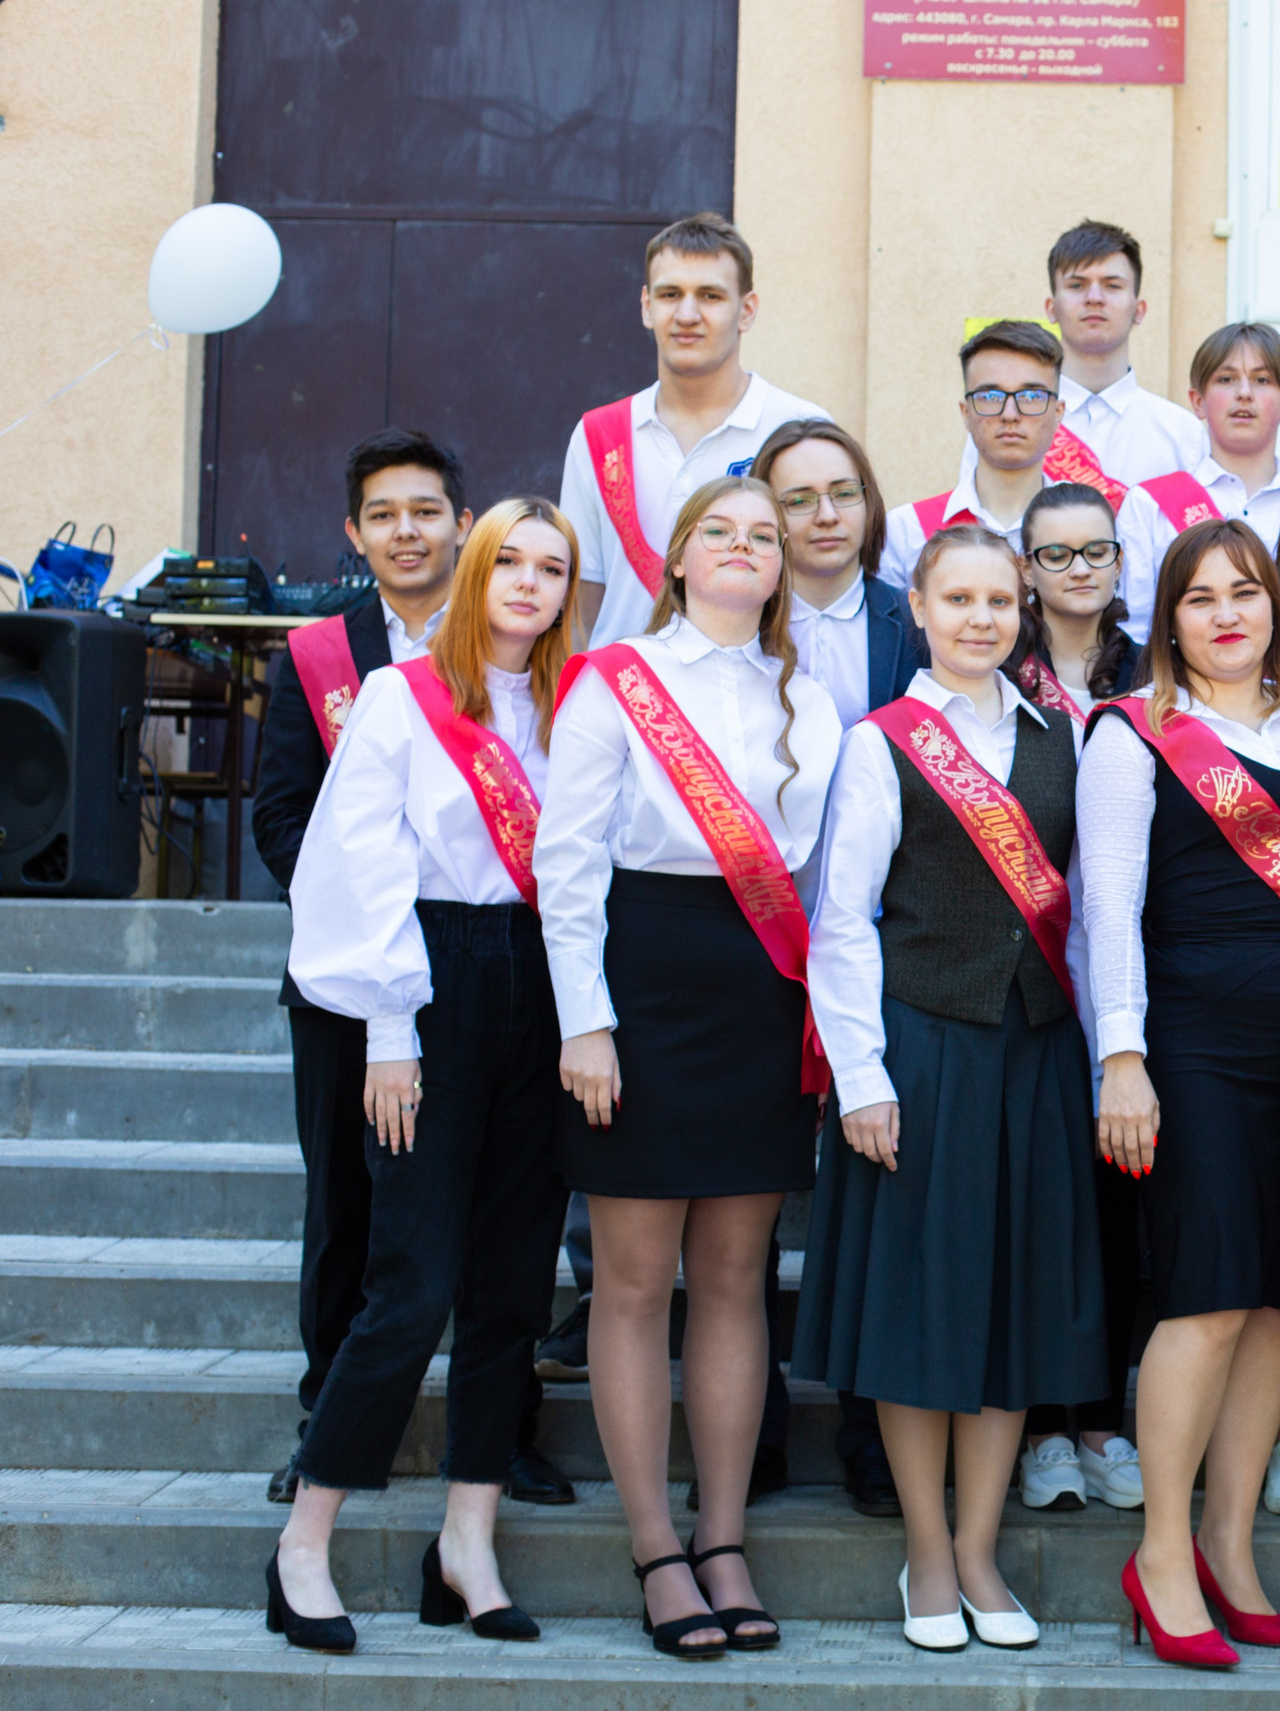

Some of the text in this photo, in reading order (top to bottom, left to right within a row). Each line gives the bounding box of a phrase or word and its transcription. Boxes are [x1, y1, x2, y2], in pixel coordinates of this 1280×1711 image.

[902, 32, 945, 45] режим
[1096, 35, 1149, 49] суббота
[983, 13, 1035, 27] Самара,
[1059, 15, 1099, 28] Карла
[1100, 15, 1153, 28] Маркса,
[1156, 16, 1180, 28] 183
[644, 705, 801, 925] Выпускник 2024
[937, 760, 1062, 911] Выпускник
